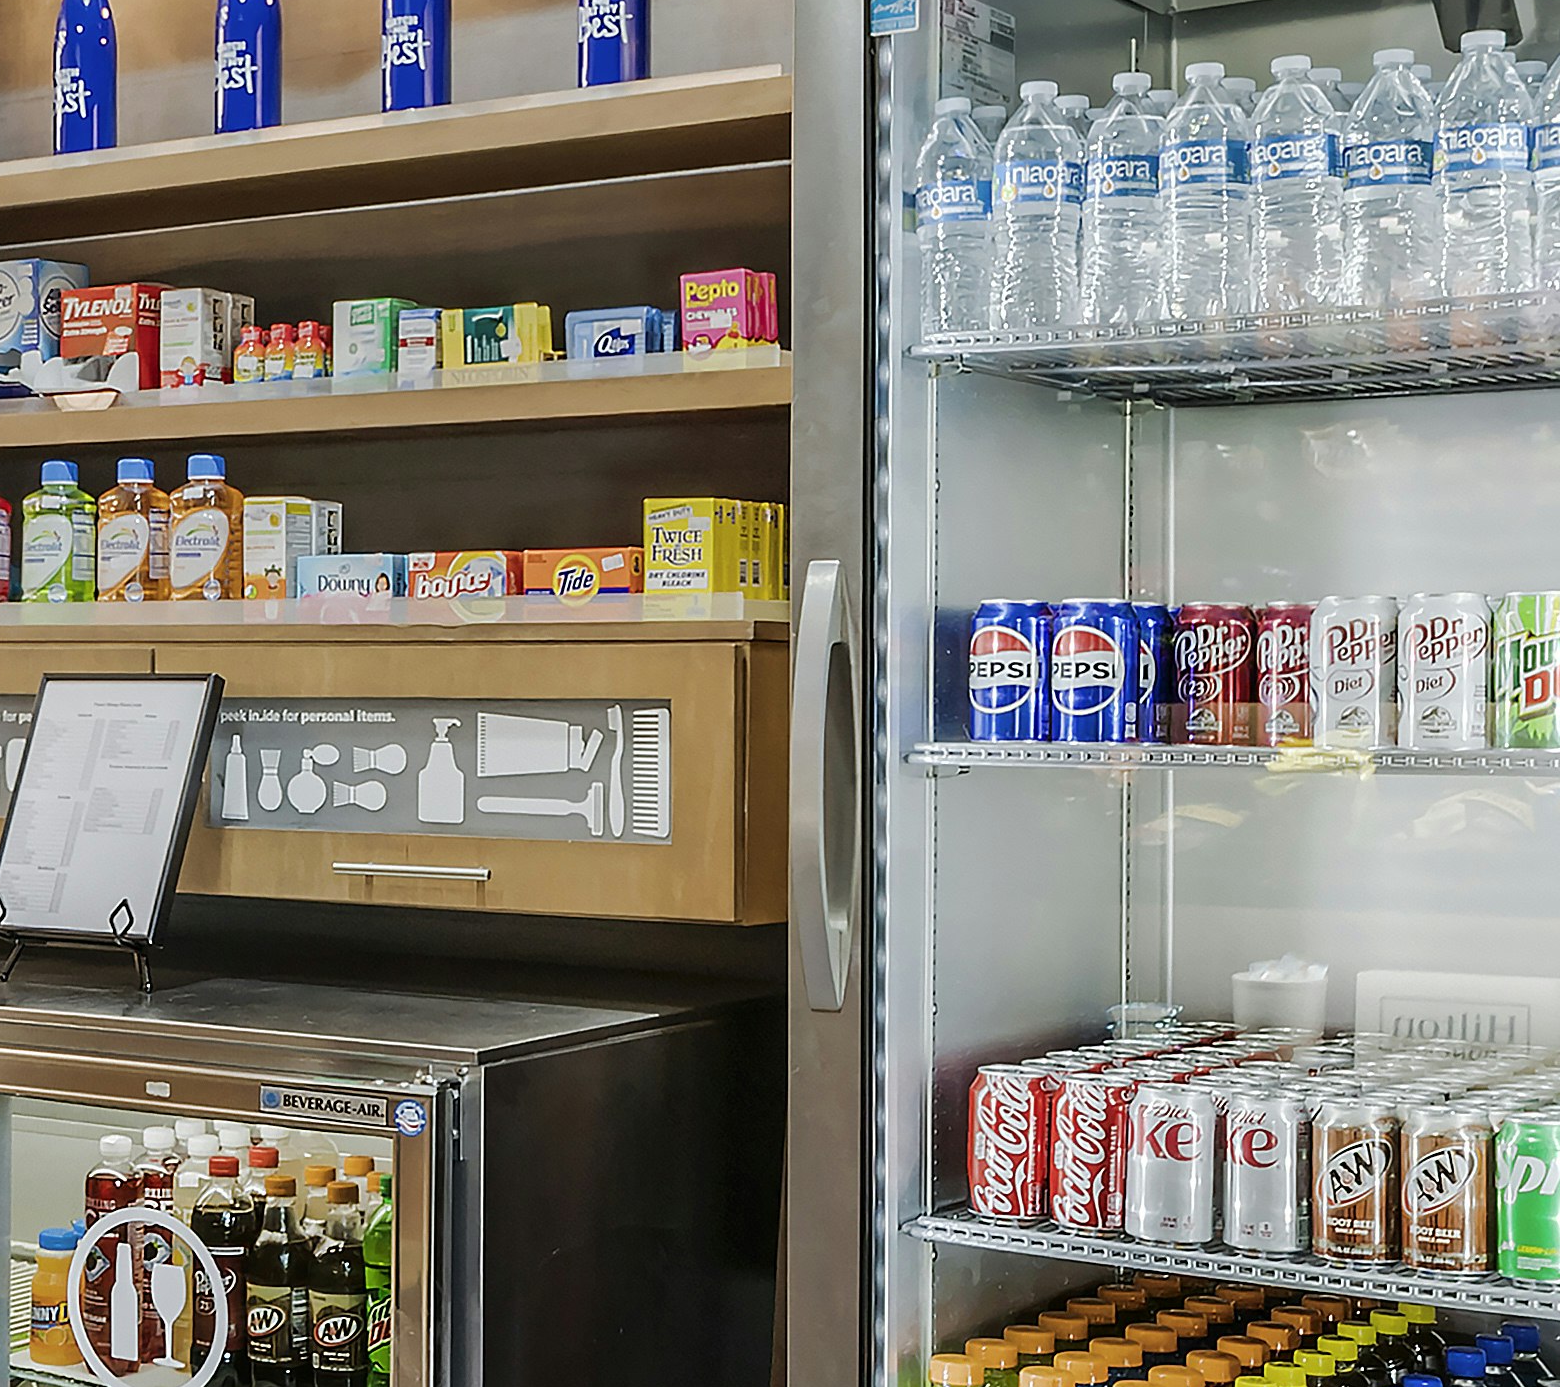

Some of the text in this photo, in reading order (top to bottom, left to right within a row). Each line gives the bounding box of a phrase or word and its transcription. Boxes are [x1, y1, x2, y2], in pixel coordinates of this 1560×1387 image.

[685, 278, 740, 302] Pepto
[63, 297, 132, 321] TYLENOL
[652, 526, 703, 544] TWICE
[652, 545, 703, 566] FRESH
[318, 574, 370, 596] Downy
[558, 566, 594, 596] Tide
[1197, 625, 1228, 650] Dr
[1349, 618, 1379, 642] Dr
[1430, 616, 1464, 640] Dr
[1176, 631, 1248, 667] Pepper
[1322, 625, 1398, 666] Pepper
[1405, 624, 1484, 663] Pepper
[1334, 674, 1363, 695] Diet
[1415, 674, 1444, 694] Diet
[282, 709, 300, 722] for
[301, 709, 354, 725] personal
